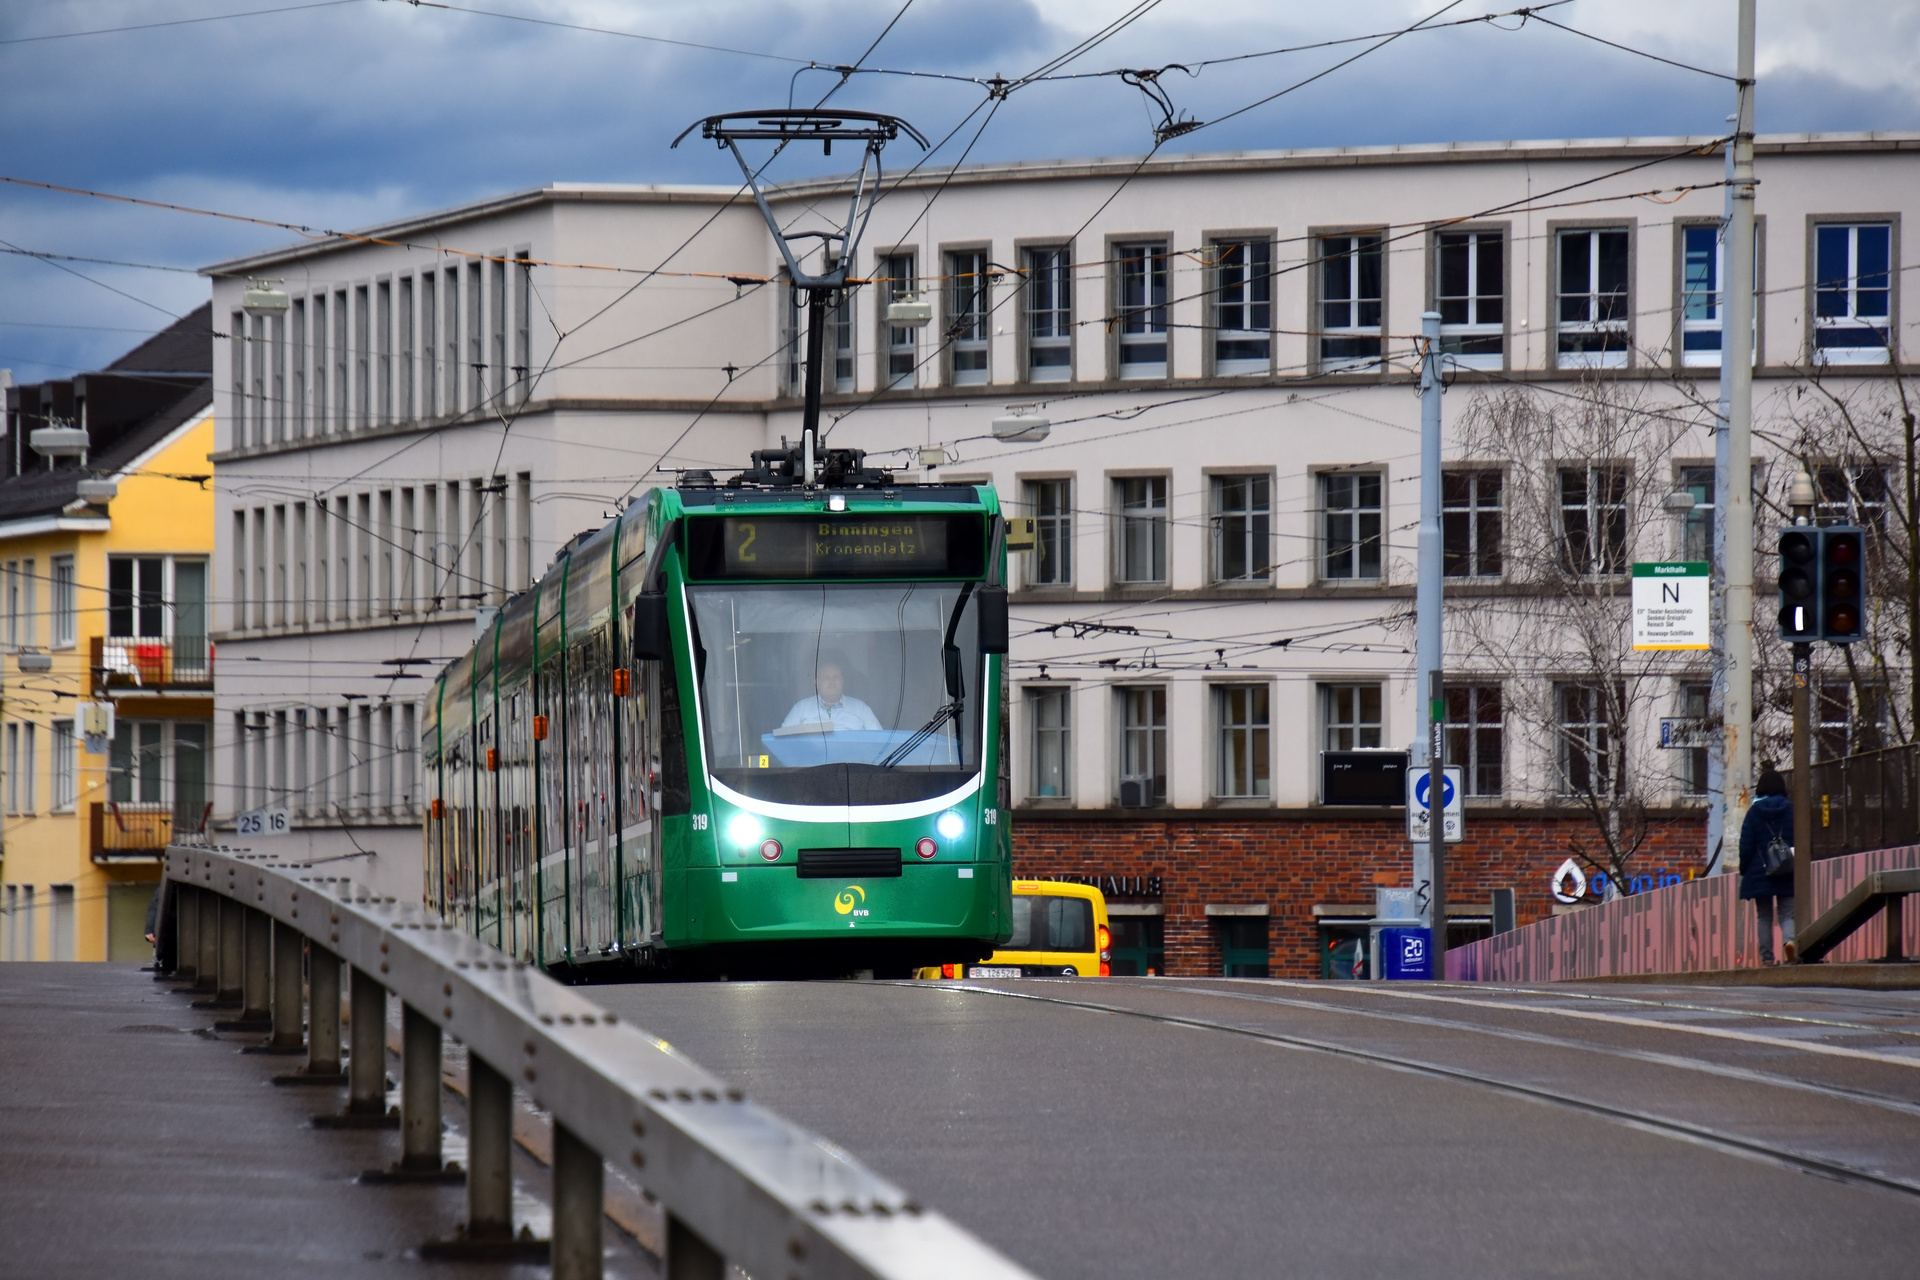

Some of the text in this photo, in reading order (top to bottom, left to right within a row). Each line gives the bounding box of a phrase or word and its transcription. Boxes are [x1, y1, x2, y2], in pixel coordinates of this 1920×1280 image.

[818, 523, 914, 538] Binningen
[737, 523, 756, 562] 2
[815, 541, 917, 556] Kronenplatz
[1654, 566, 1687, 574] Markthalle
[1662, 582, 1679, 603] N
[1434, 722, 1442, 759] Markthalle
[761, 758, 767, 766] 2
[241, 815, 261, 833] 25
[270, 813, 285, 830] 16
[692, 813, 708, 831] 319
[984, 808, 997, 825] 319
[1404, 938, 1423, 957] 20
